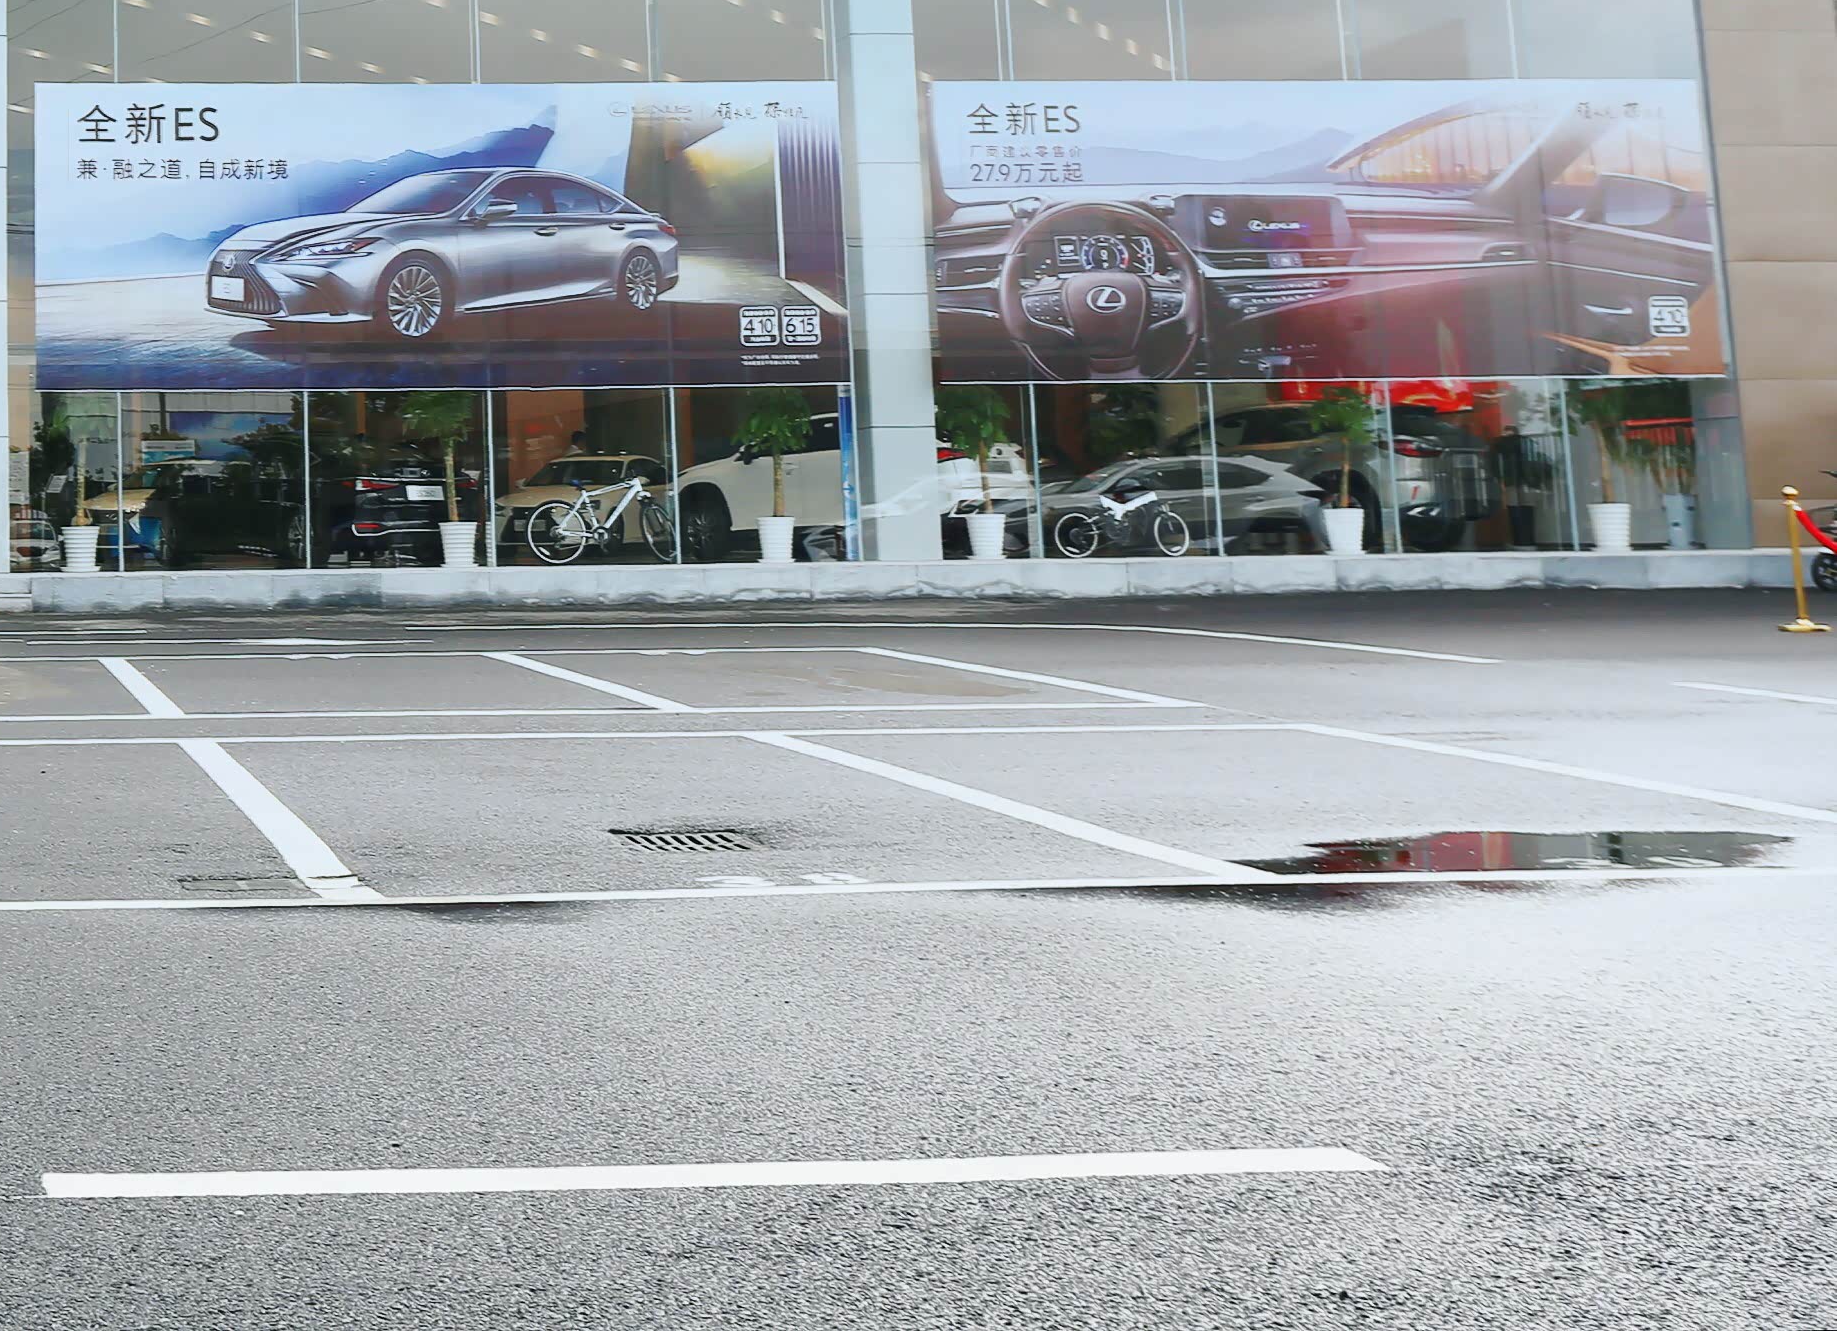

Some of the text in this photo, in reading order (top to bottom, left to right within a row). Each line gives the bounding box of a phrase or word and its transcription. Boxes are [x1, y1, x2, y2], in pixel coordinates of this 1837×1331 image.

[76, 103, 220, 144] 全新ES
[966, 102, 1081, 135] 全新ES
[969, 145, 1083, 158] 厂商建议零售价
[969, 162, 1084, 183] 27.9万元起
